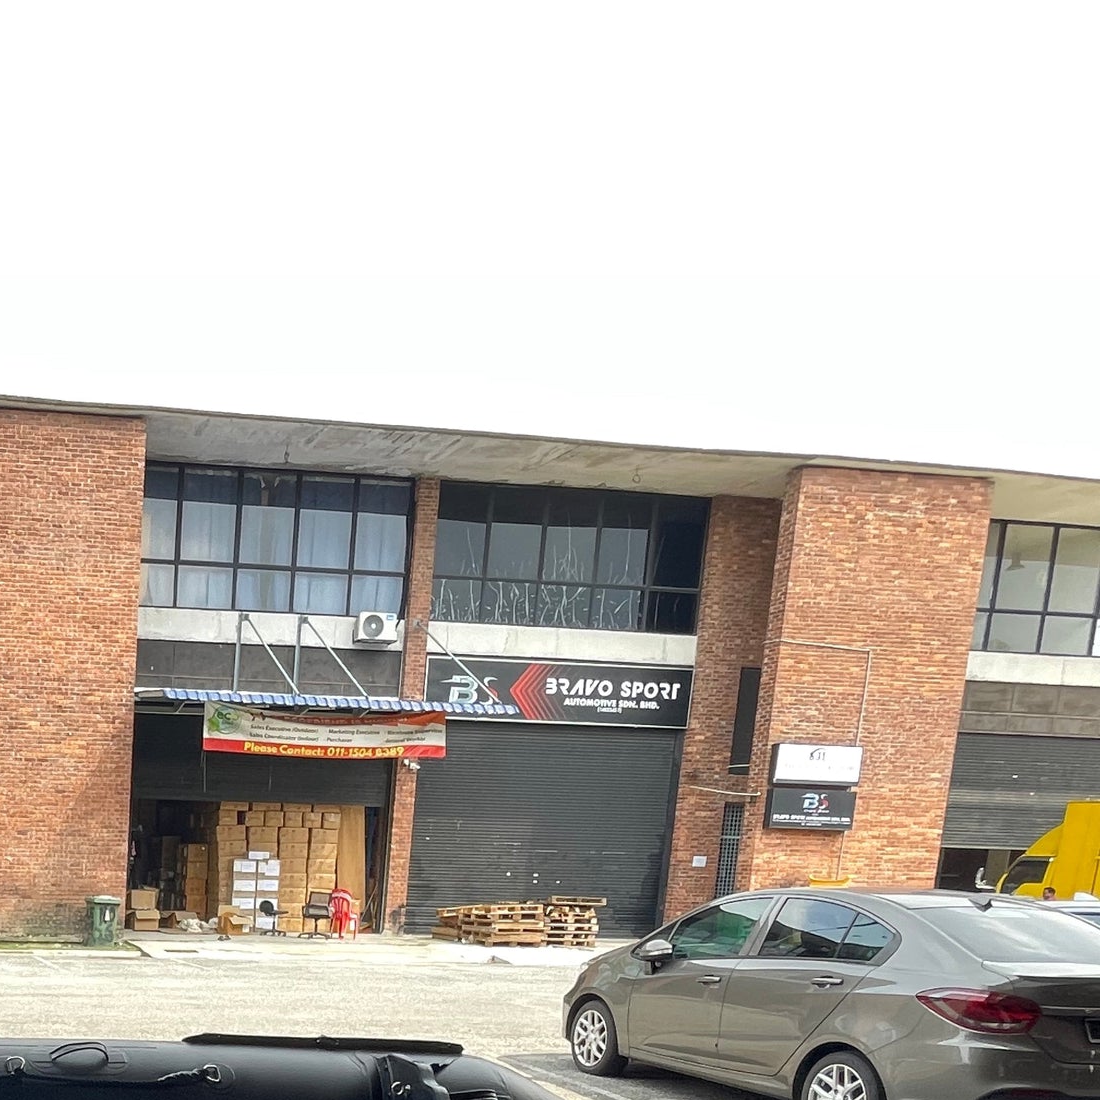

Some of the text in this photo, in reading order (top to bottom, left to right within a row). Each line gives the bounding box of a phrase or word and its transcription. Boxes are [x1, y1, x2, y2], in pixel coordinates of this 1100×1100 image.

[545, 677, 614, 697] BRAVO
[620, 681, 681, 700] SPORT
[563, 697, 617, 707] AUTOMOTIVE
[640, 701, 660, 710] BHD.
[243, 741, 278, 753] Please
[279, 744, 325, 757] Contact:
[326, 747, 373, 758] 011-1504
